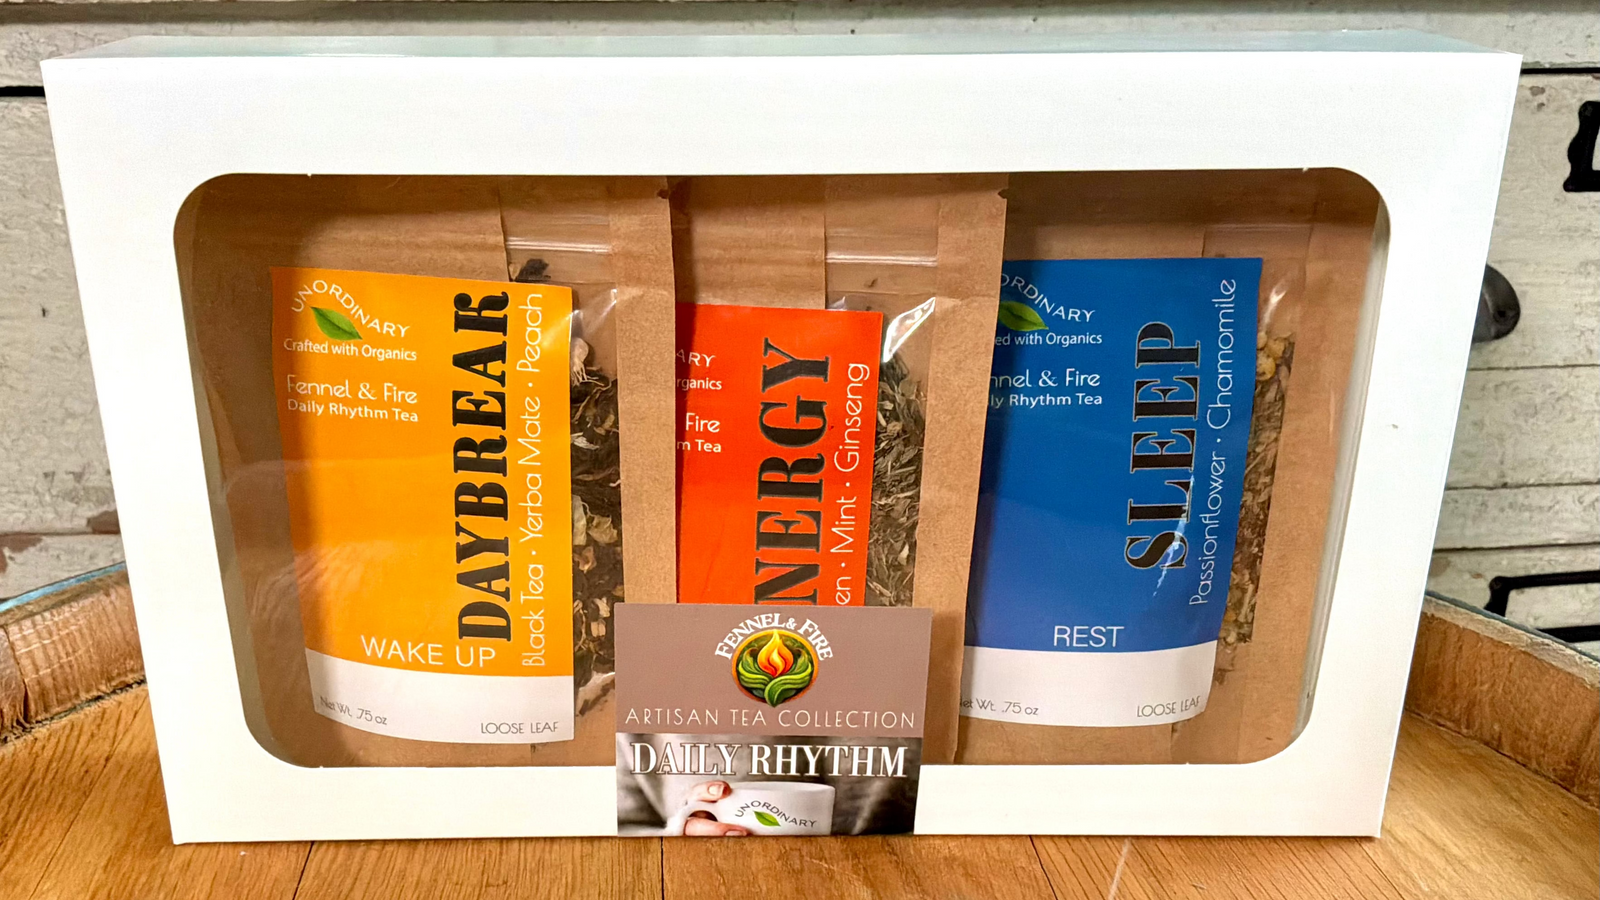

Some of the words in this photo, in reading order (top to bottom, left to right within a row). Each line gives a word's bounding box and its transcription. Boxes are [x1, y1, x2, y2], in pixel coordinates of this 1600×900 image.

[291, 279, 410, 338] UNORDINARY
[516, 293, 543, 372] Peach
[1014, 333, 1042, 345] with
[1046, 332, 1102, 347] Organics
[284, 338, 328, 353] Crafted
[331, 343, 358, 356] with
[362, 344, 417, 361] Organics
[1207, 279, 1236, 429] Chamomile
[287, 374, 352, 398] Fennel
[358, 382, 377, 400] &
[384, 382, 417, 404] Fire
[1038, 370, 1058, 387] &
[1066, 368, 1100, 387] Fire
[287, 399, 324, 416] Daily
[329, 402, 388, 419] Rhythm
[392, 407, 418, 422] Tea
[1009, 393, 1071, 409] Rhythm
[1075, 392, 1102, 405] Tea
[518, 396, 541, 465] Mate
[685, 412, 721, 433] Fire
[834, 363, 870, 472] Ginseng
[695, 439, 722, 453] Tea
[1124, 321, 1200, 570] SLEEP
[452, 291, 511, 642] DAYBREAK
[519, 473, 543, 542] Yerba
[830, 496, 856, 553] Mint
[1189, 452, 1226, 605] Passionflower
[520, 564, 544, 604] Tea
[361, 635, 444, 666] WAKE
[455, 645, 496, 668] UP
[522, 609, 545, 667] Black
[714, 612, 786, 660] FENNEL
[785, 617, 797, 630] &
[797, 618, 834, 661] FIRE
[1053, 625, 1125, 648] REST
[375, 715, 388, 726] oz
[624, 708, 719, 726] ARTISAN
[730, 708, 767, 727] TEA
[778, 710, 916, 729] COLLECTION
[960, 696, 973, 709] et
[1001, 701, 1021, 715] .75
[1025, 707, 1039, 716] oz
[1136, 702, 1177, 718] LOOSE
[1180, 696, 1201, 712] LEAF
[480, 721, 525, 735] LOOSE
[531, 720, 559, 734] LEAF
[630, 741, 741, 775] DAILY
[749, 743, 909, 779] RHYTHM
[735, 799, 817, 828] UNORDINARY
